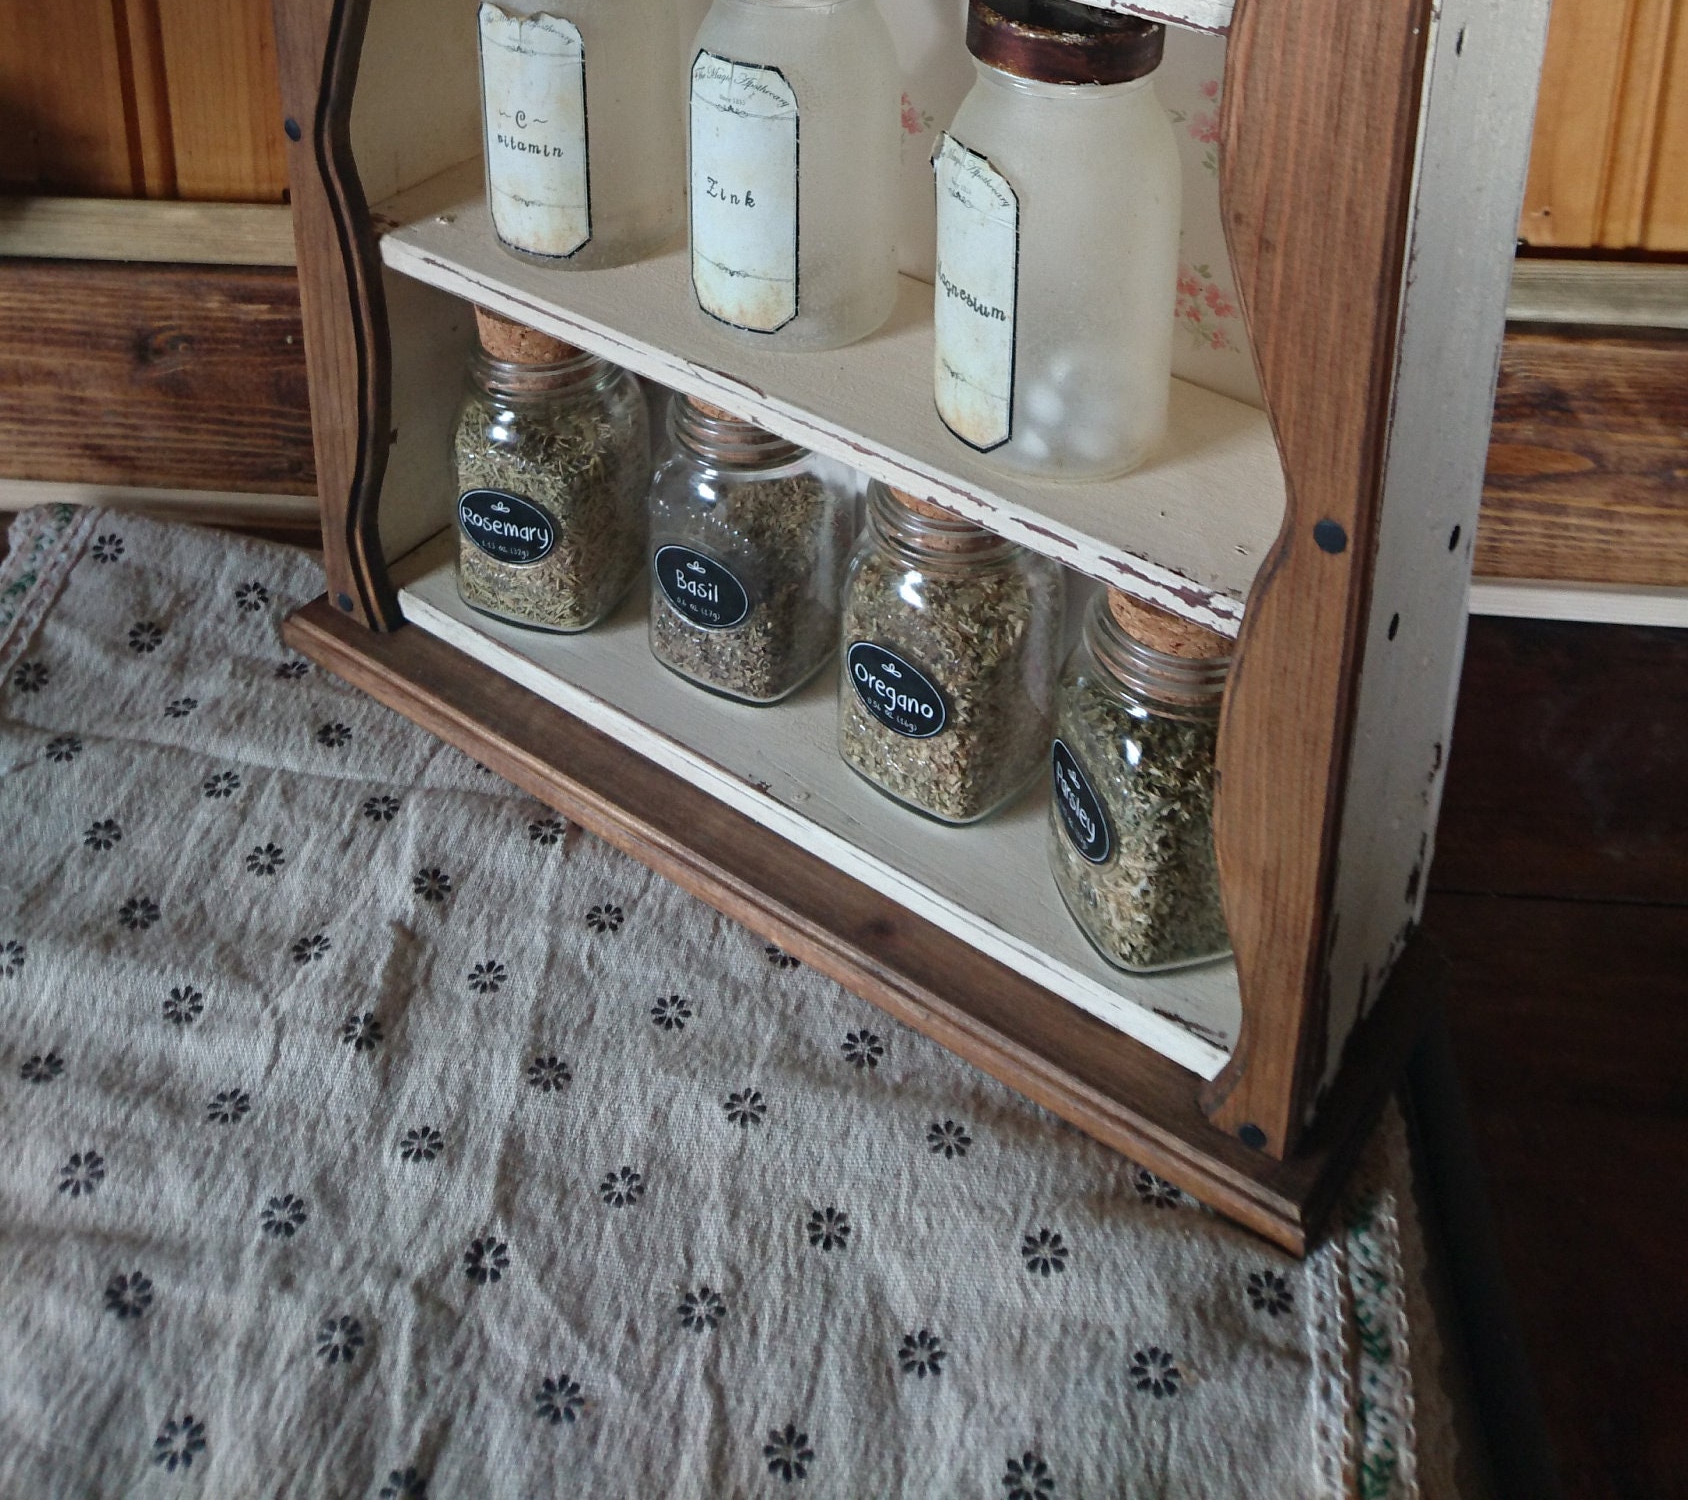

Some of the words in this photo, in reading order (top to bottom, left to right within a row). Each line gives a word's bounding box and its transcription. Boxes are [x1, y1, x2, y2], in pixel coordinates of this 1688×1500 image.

[706, 176, 756, 208] Zink
[462, 506, 549, 550] Rosemary
[676, 568, 718, 603] Basil
[854, 662, 934, 719] Oregano
[1056, 760, 1096, 843] Parsley
